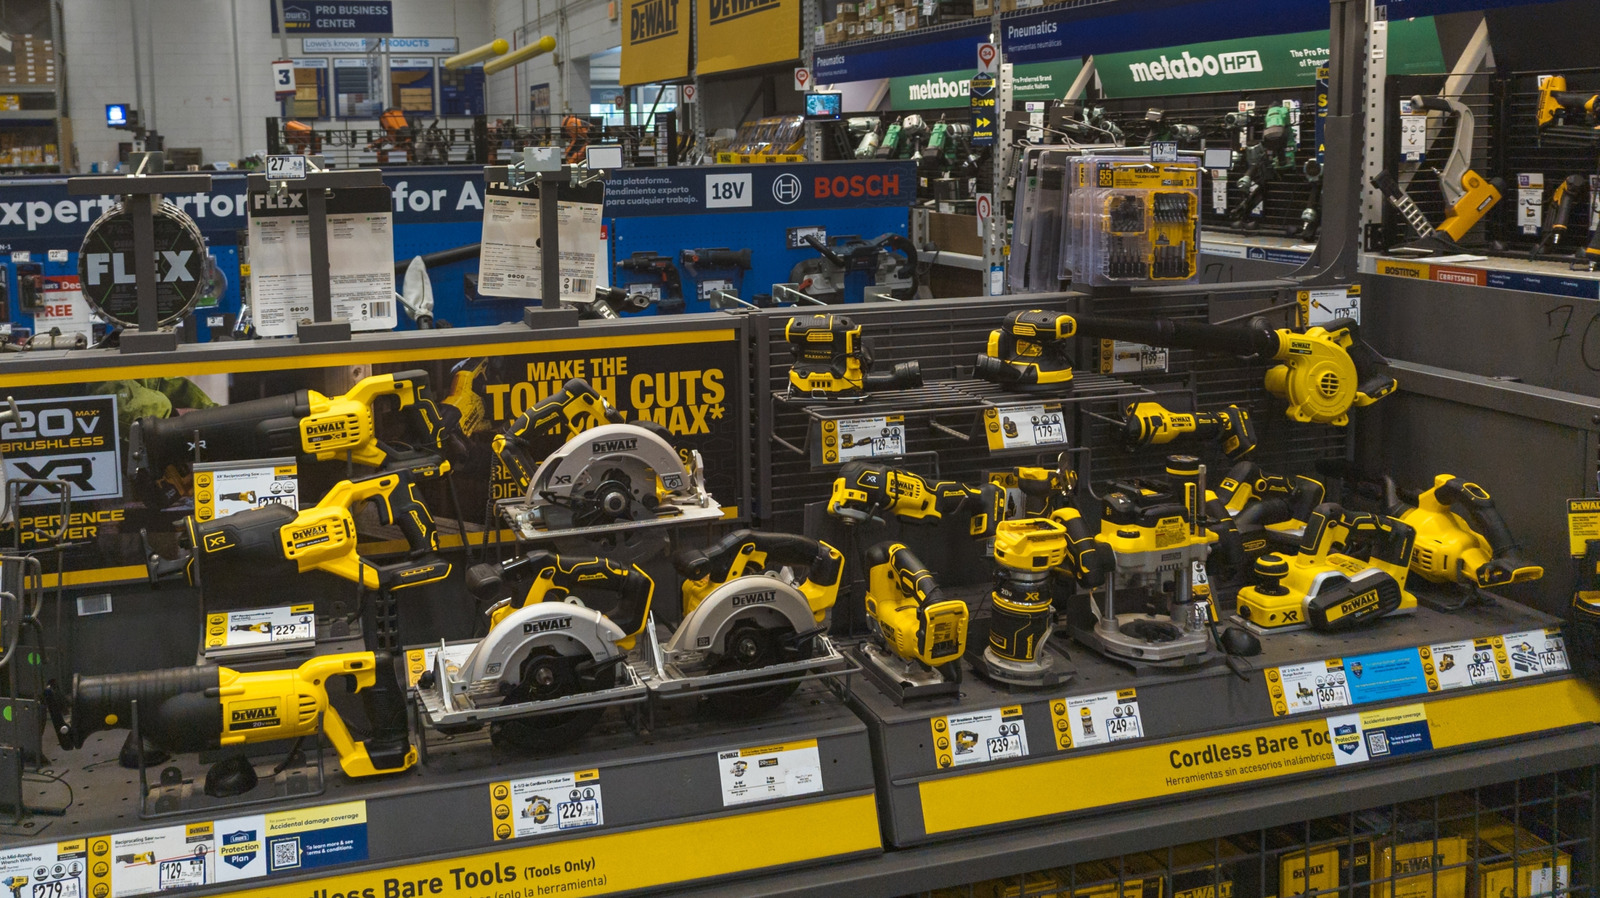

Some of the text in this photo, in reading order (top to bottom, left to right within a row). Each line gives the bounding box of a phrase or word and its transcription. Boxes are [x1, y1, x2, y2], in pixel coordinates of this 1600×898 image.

[316, 5, 388, 15] PRO BUSINESS
[1375, 6, 1387, 20] 14
[316, 19, 356, 28] CENTER
[631, 1, 678, 41] DEWALT
[1008, 20, 1058, 39] Pneumatics
[305, 40, 332, 48] Lowe's
[333, 40, 360, 48] knows
[1290, 47, 1330, 58] The Pro Pre
[816, 55, 845, 67] Pneumatics
[1129, 51, 1259, 82] metabo HPT
[1299, 59, 1307, 67] of
[278, 70, 290, 85] 3
[909, 77, 958, 100] metabo
[971, 97, 995, 107] Save
[622, 176, 672, 187] plataforma.
[814, 174, 899, 198] BOSCH
[392, 181, 447, 212] for
[456, 181, 483, 211] A
[606, 185, 689, 196] Rendimiento experto
[712, 181, 745, 200] 18V
[254, 193, 303, 209] FLEX
[606, 195, 698, 206] para cualquier trabajo.
[86, 251, 195, 286] FLX
[1385, 266, 1420, 277] BOSTITCH
[1439, 273, 1475, 283] CRAFTSMAN
[36, 304, 72, 318] REE
[1291, 341, 1311, 349] DEWALT
[527, 356, 628, 381] MAKE THE
[630, 368, 726, 410] CUTS
[306, 421, 346, 434] DEWALT
[0, 436, 104, 453] BRUSHLESS
[187, 440, 206, 451] XR
[593, 438, 637, 453] DEWALT
[13, 457, 96, 497] XR
[555, 475, 571, 484] XR
[1571, 502, 1600, 511] DEWAL
[20, 525, 97, 544] POWER
[292, 525, 328, 540] DEWALT
[209, 536, 226, 547] XR
[732, 592, 777, 606] DEWALT
[1024, 592, 1040, 601] XR
[1341, 592, 1377, 614] DEWALT
[1282, 610, 1298, 622] XR
[523, 617, 572, 634] DEWALT
[232, 708, 277, 721] DEWALT
[1335, 735, 1359, 743] Protection
[1169, 728, 1330, 769] Cordless Bare Too
[1166, 751, 1335, 787] Herramientas sin accesorios inalámbricos
[270, 819, 303, 831] Accidental
[304, 815, 330, 827] damage
[331, 812, 359, 823] coverage
[115, 837, 144, 846] Reciprocating
[326, 844, 353, 853] conditions.
[221, 843, 259, 855] Protection
[231, 854, 249, 863] Plan
[162, 862, 182, 880] $129
[384, 857, 596, 898] Bare Tools (Tools Only)
[523, 885, 535, 897] la
[537, 874, 607, 896] herramienta)
